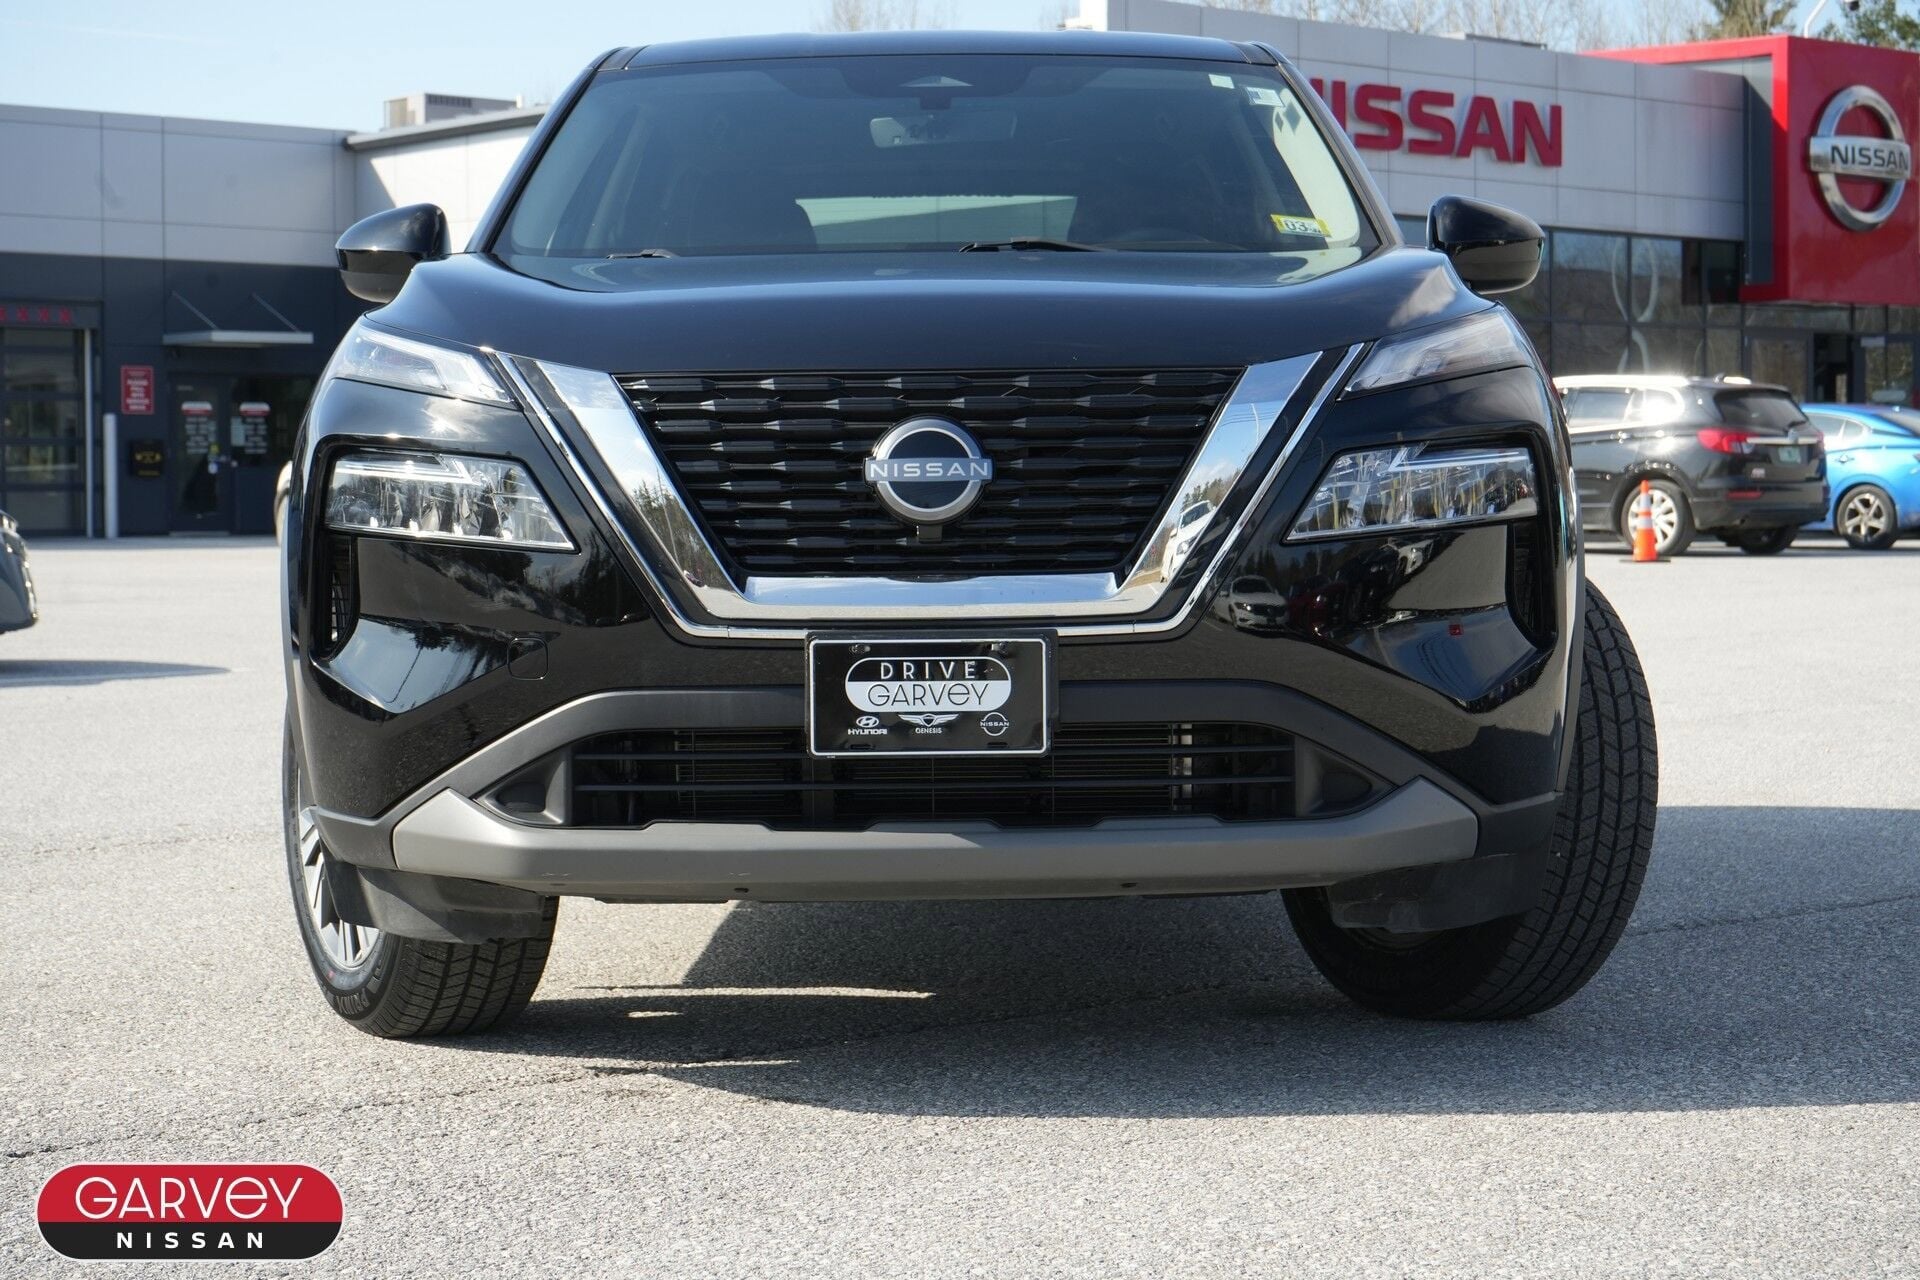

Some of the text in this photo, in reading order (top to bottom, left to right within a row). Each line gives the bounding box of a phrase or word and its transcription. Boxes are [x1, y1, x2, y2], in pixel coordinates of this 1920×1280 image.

[1310, 78, 1562, 168] ISSAN
[1830, 145, 1909, 171] NISSAN
[870, 462, 988, 478] NISSAN
[880, 660, 977, 680] DRIVE
